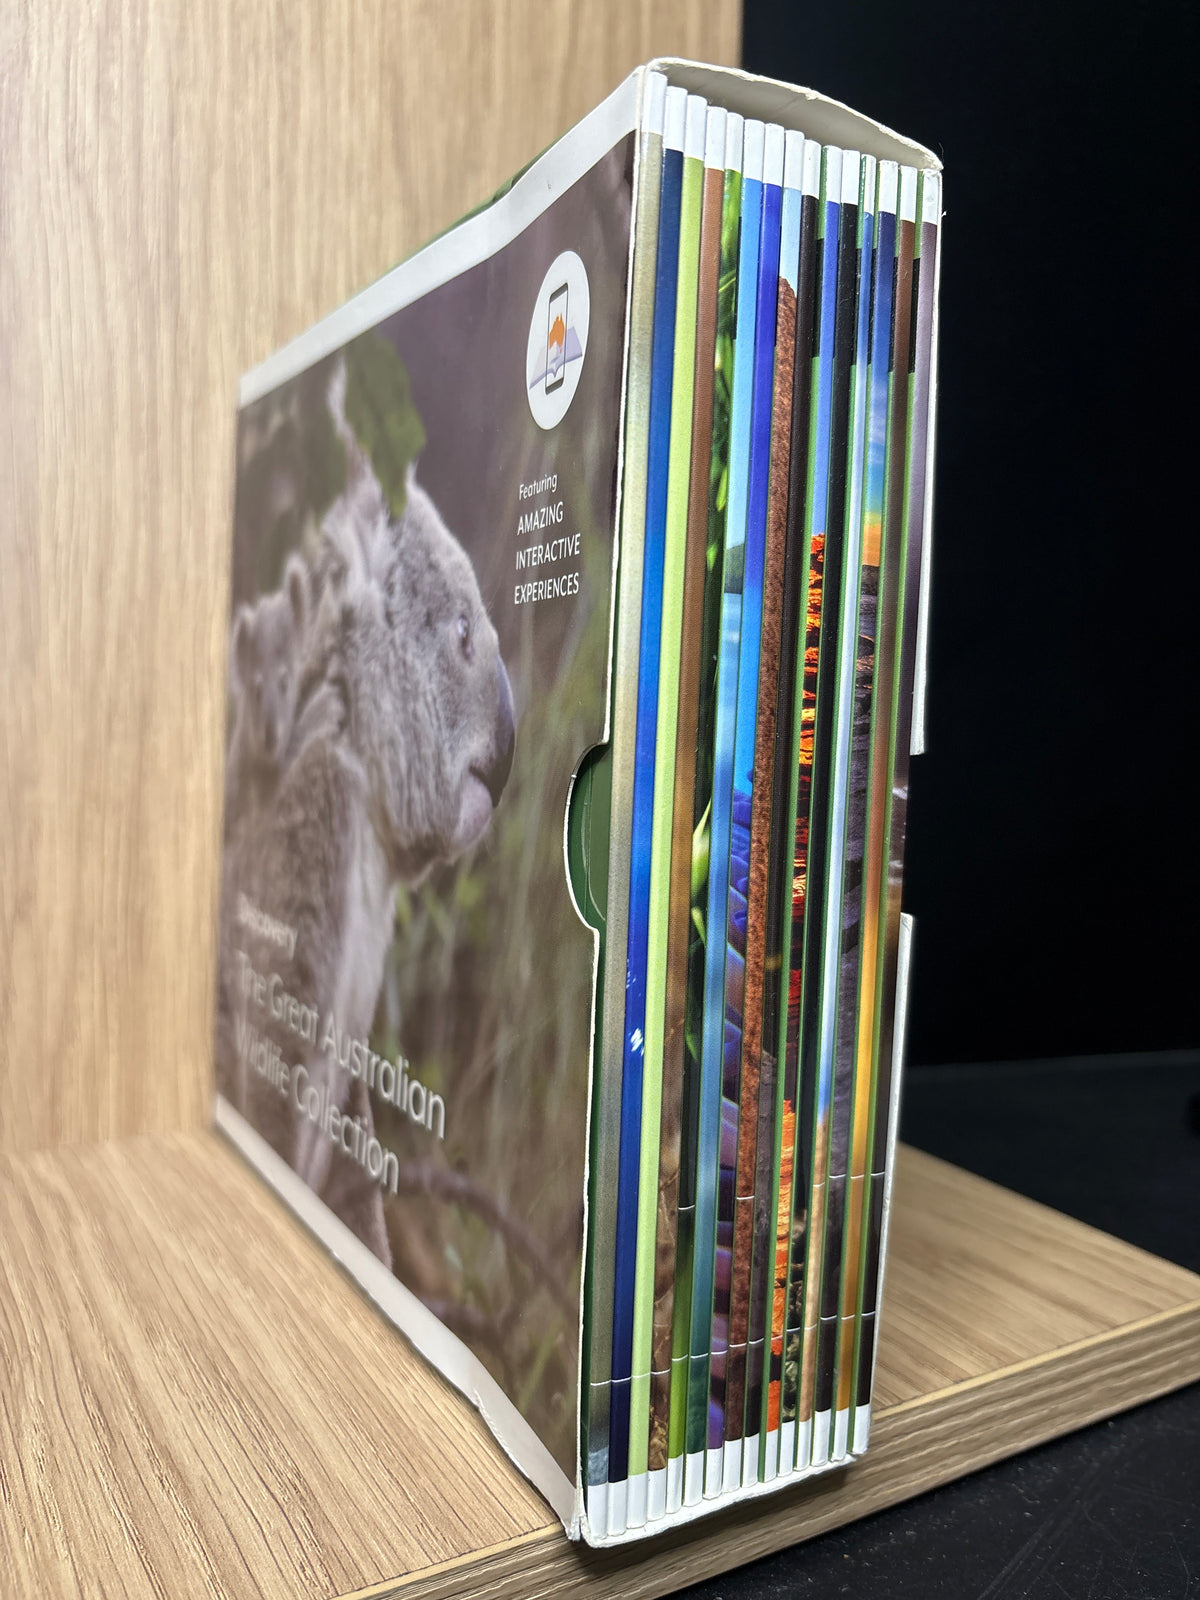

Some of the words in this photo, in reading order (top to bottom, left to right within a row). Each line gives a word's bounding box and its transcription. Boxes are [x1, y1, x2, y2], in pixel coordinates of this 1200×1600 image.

[519, 474, 558, 500] Featuring
[516, 501, 563, 536] AMAZING
[516, 533, 581, 571] INTERACTIVE
[514, 572, 580, 604] EXPERIENCES
[236, 950, 267, 1006] The
[269, 972, 319, 1043] Great
[323, 1014, 445, 1140] Australian
[294, 1066, 399, 1195] Collection
